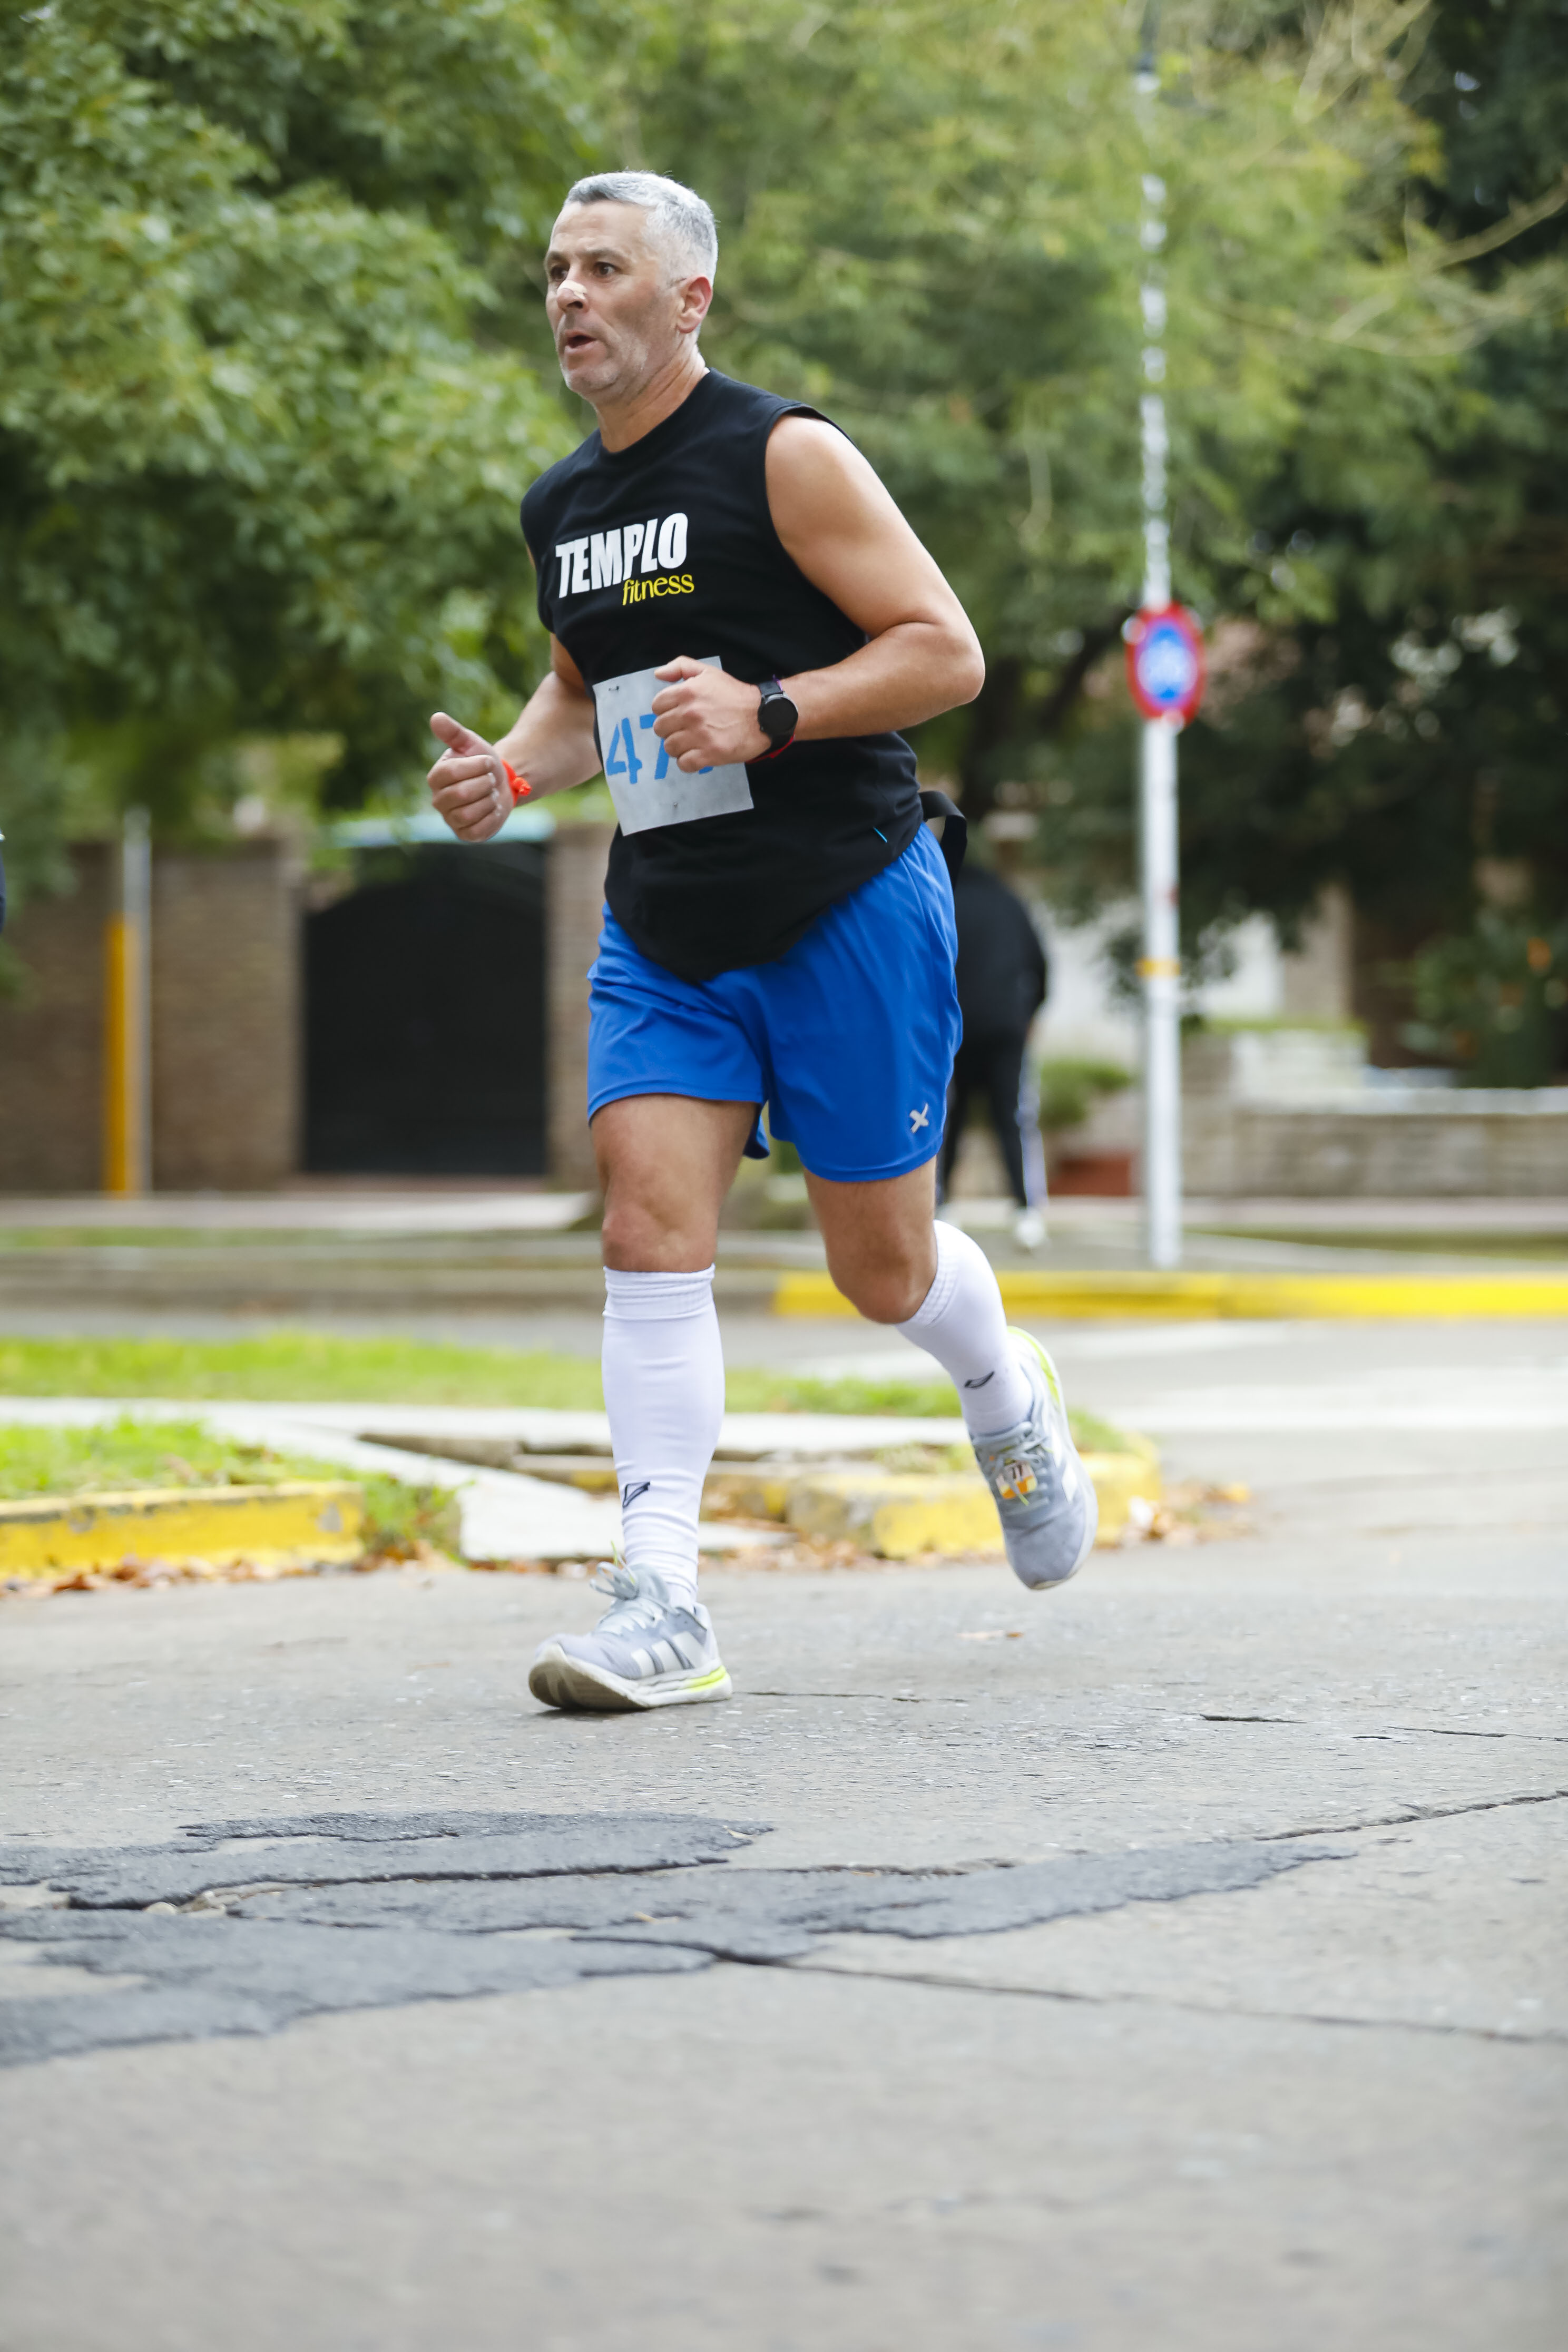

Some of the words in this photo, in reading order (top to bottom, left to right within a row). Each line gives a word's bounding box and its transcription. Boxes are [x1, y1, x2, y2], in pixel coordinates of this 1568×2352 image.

[555, 512, 688, 599] TEMPLO
[622, 573, 695, 605] fitness
[606, 713, 714, 784] 47
